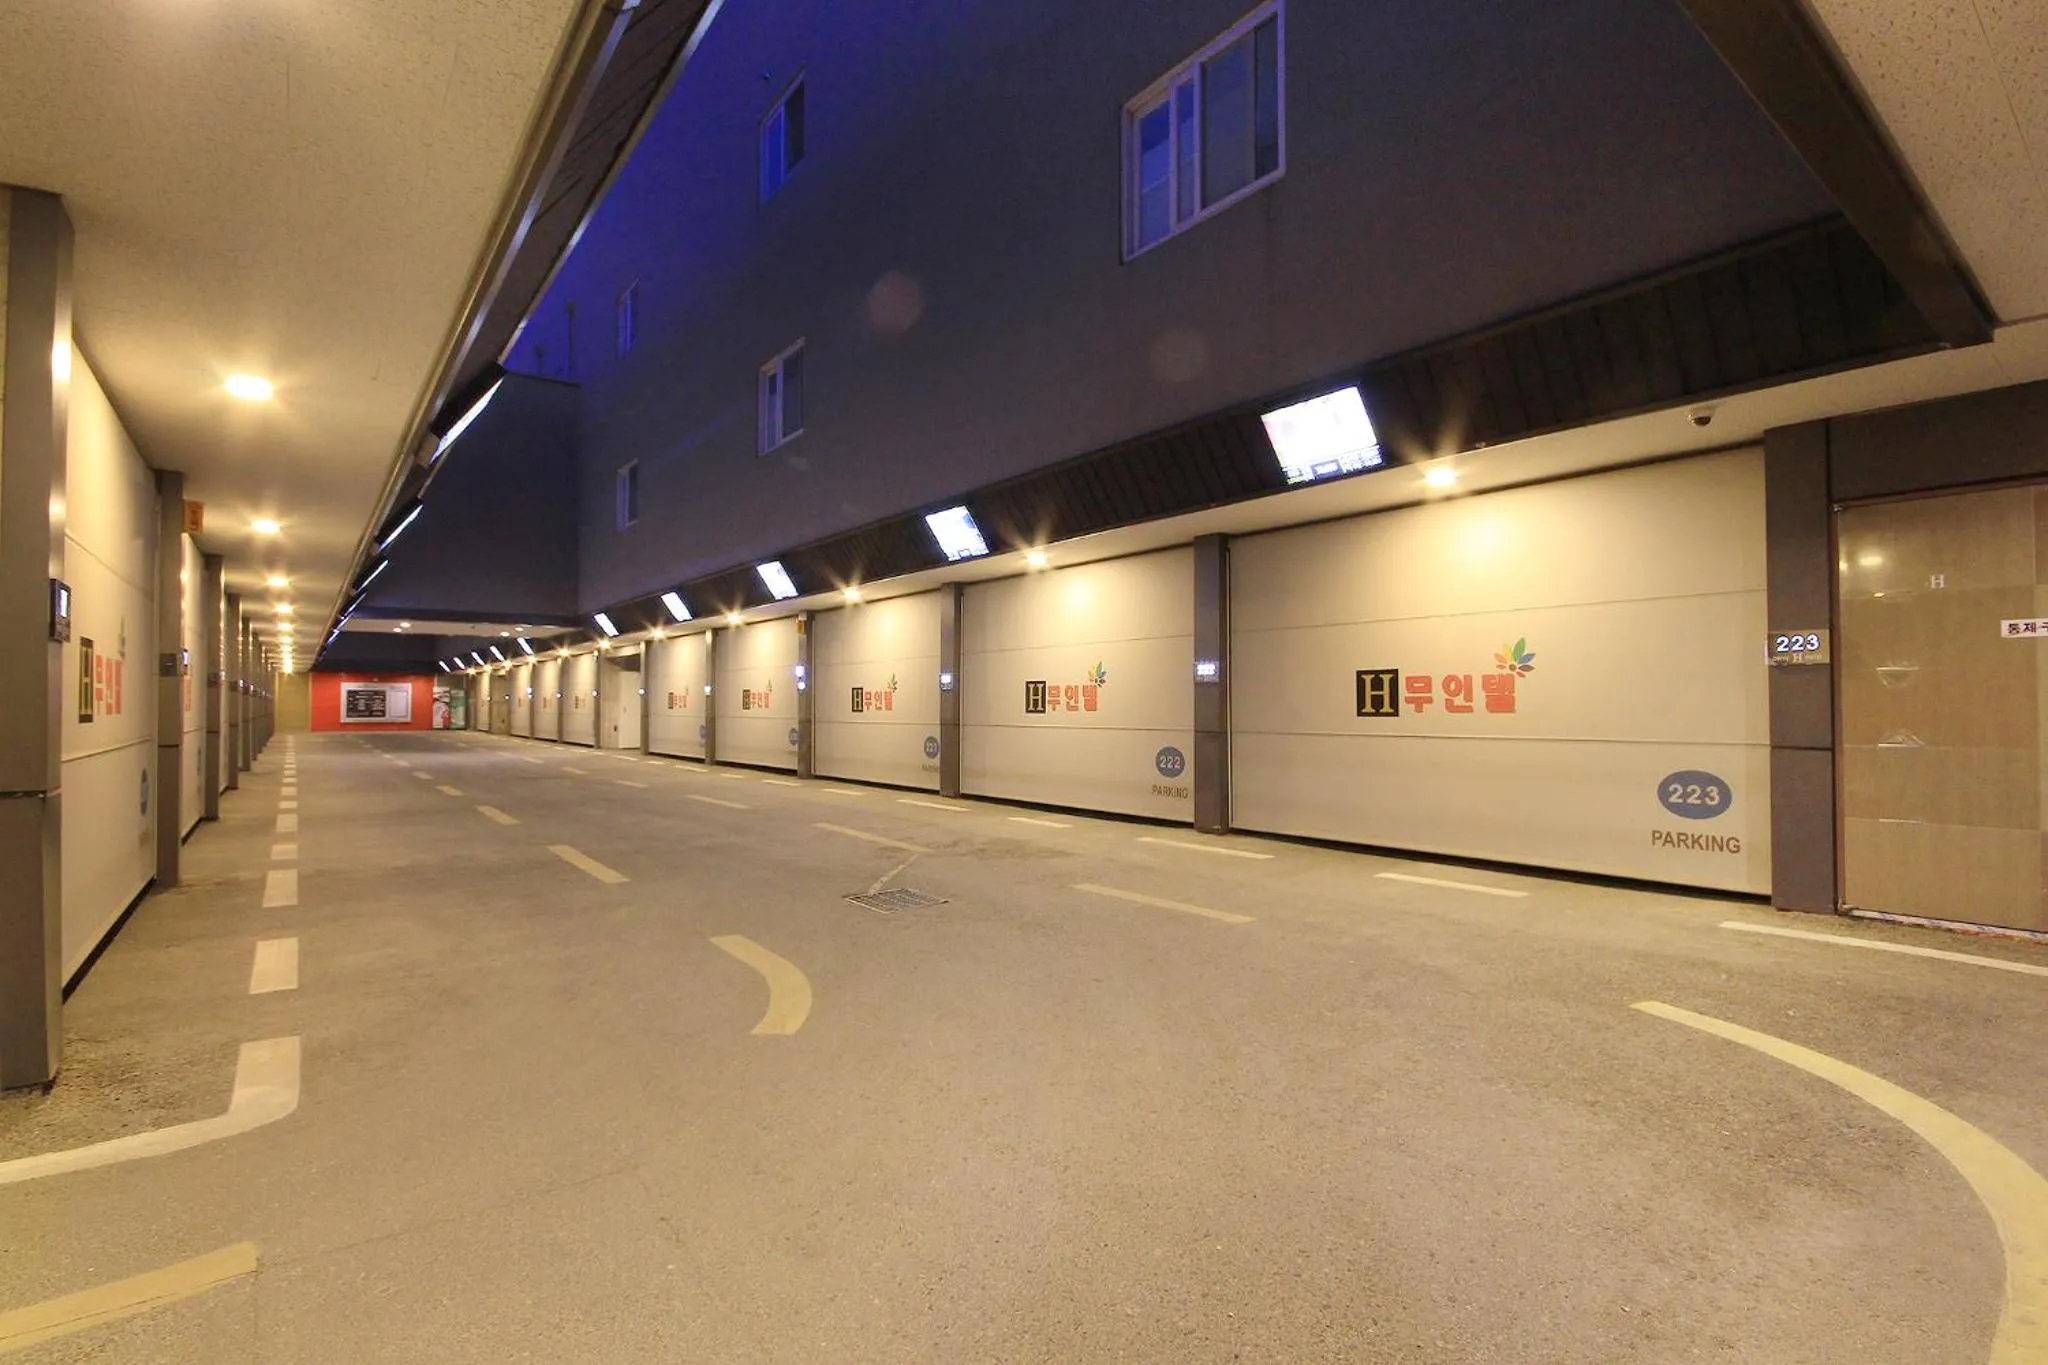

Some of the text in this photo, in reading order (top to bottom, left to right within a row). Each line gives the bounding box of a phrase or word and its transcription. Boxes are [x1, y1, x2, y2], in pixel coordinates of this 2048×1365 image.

[1776, 633, 1820, 653] 223
[1160, 755, 1180, 769] 222
[1151, 784, 1188, 799] PARKING
[1668, 783, 1720, 806] 223
[1651, 830, 1741, 854] PARKING
